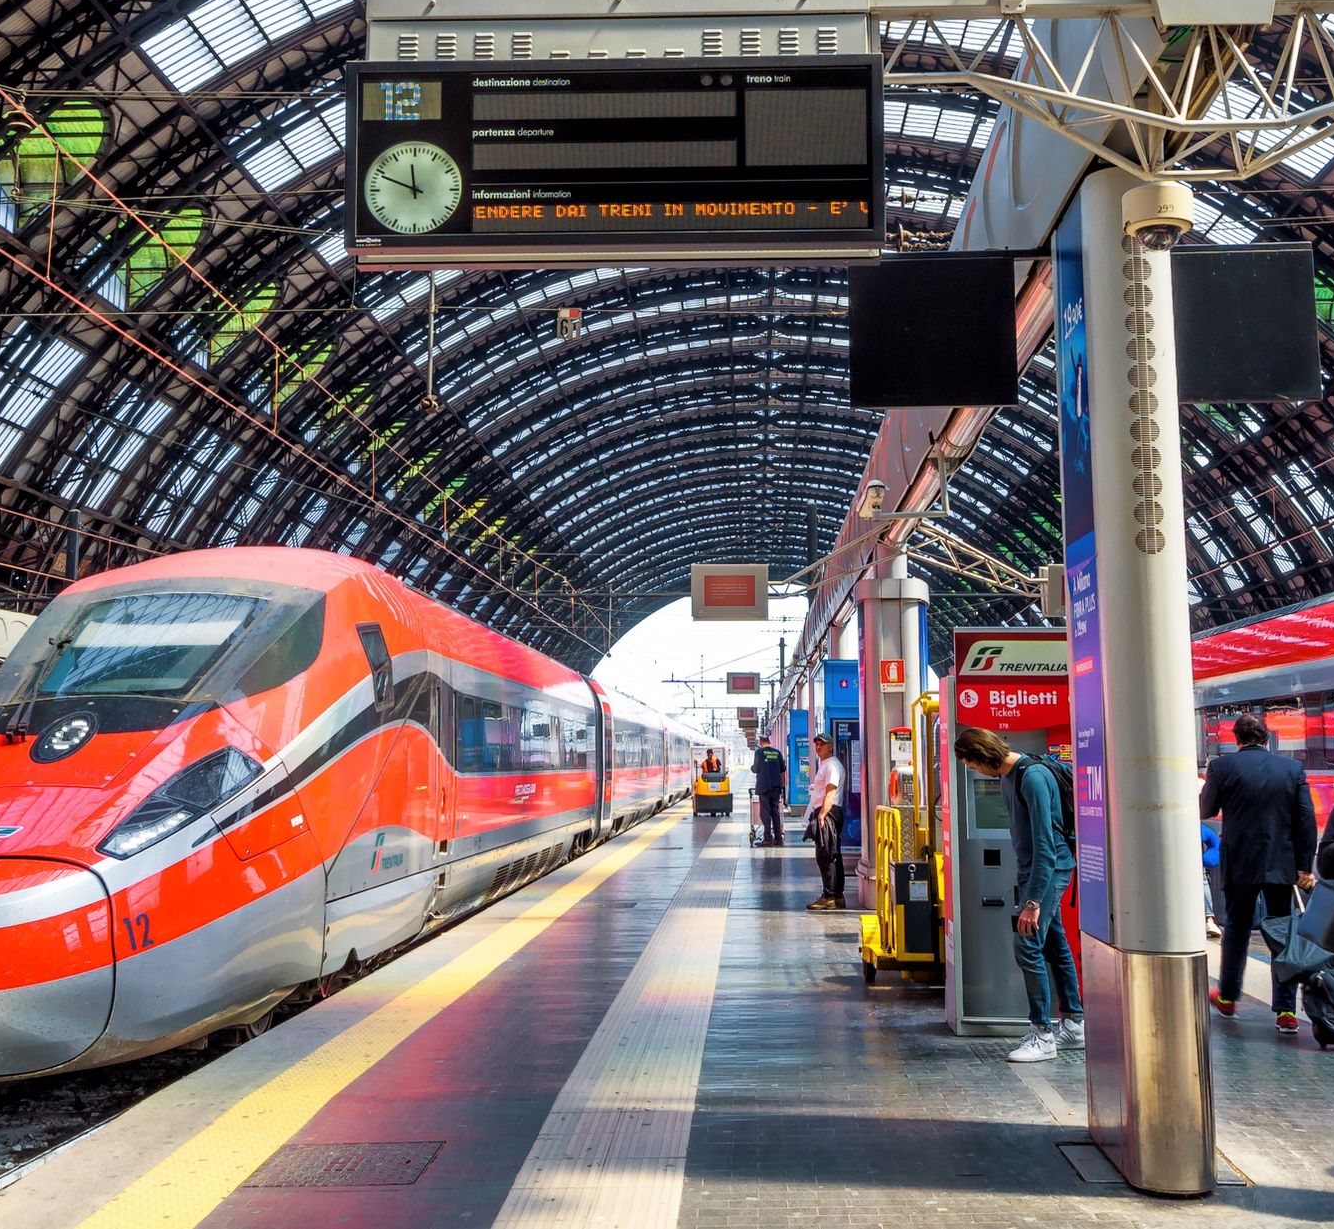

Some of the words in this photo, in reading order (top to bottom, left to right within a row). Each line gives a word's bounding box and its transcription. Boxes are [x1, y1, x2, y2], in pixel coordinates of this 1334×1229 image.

[472, 77, 531, 87] destinazione
[532, 77, 570, 87] destination
[746, 74, 772, 83] treno
[774, 74, 791, 82] train
[380, 82, 421, 121] 12
[472, 128, 516, 138] partenza
[517, 128, 555, 138] departure
[472, 189, 531, 199] informazioni
[532, 189, 572, 199] information
[473, 204, 545, 220] ENDERE
[556, 204, 587, 219] DAI
[599, 203, 653, 218] TRENI
[664, 203, 683, 217] IN
[695, 202, 796, 216] MOVIMENTO
[830, 201, 848, 215] E'
[999, 663, 1067, 672] TRENITALIA
[989, 690, 1058, 708] Biglietti
[990, 707, 1021, 717] Tickets
[1087, 766, 1102, 801] TIM
[122, 913, 154, 950] 12
